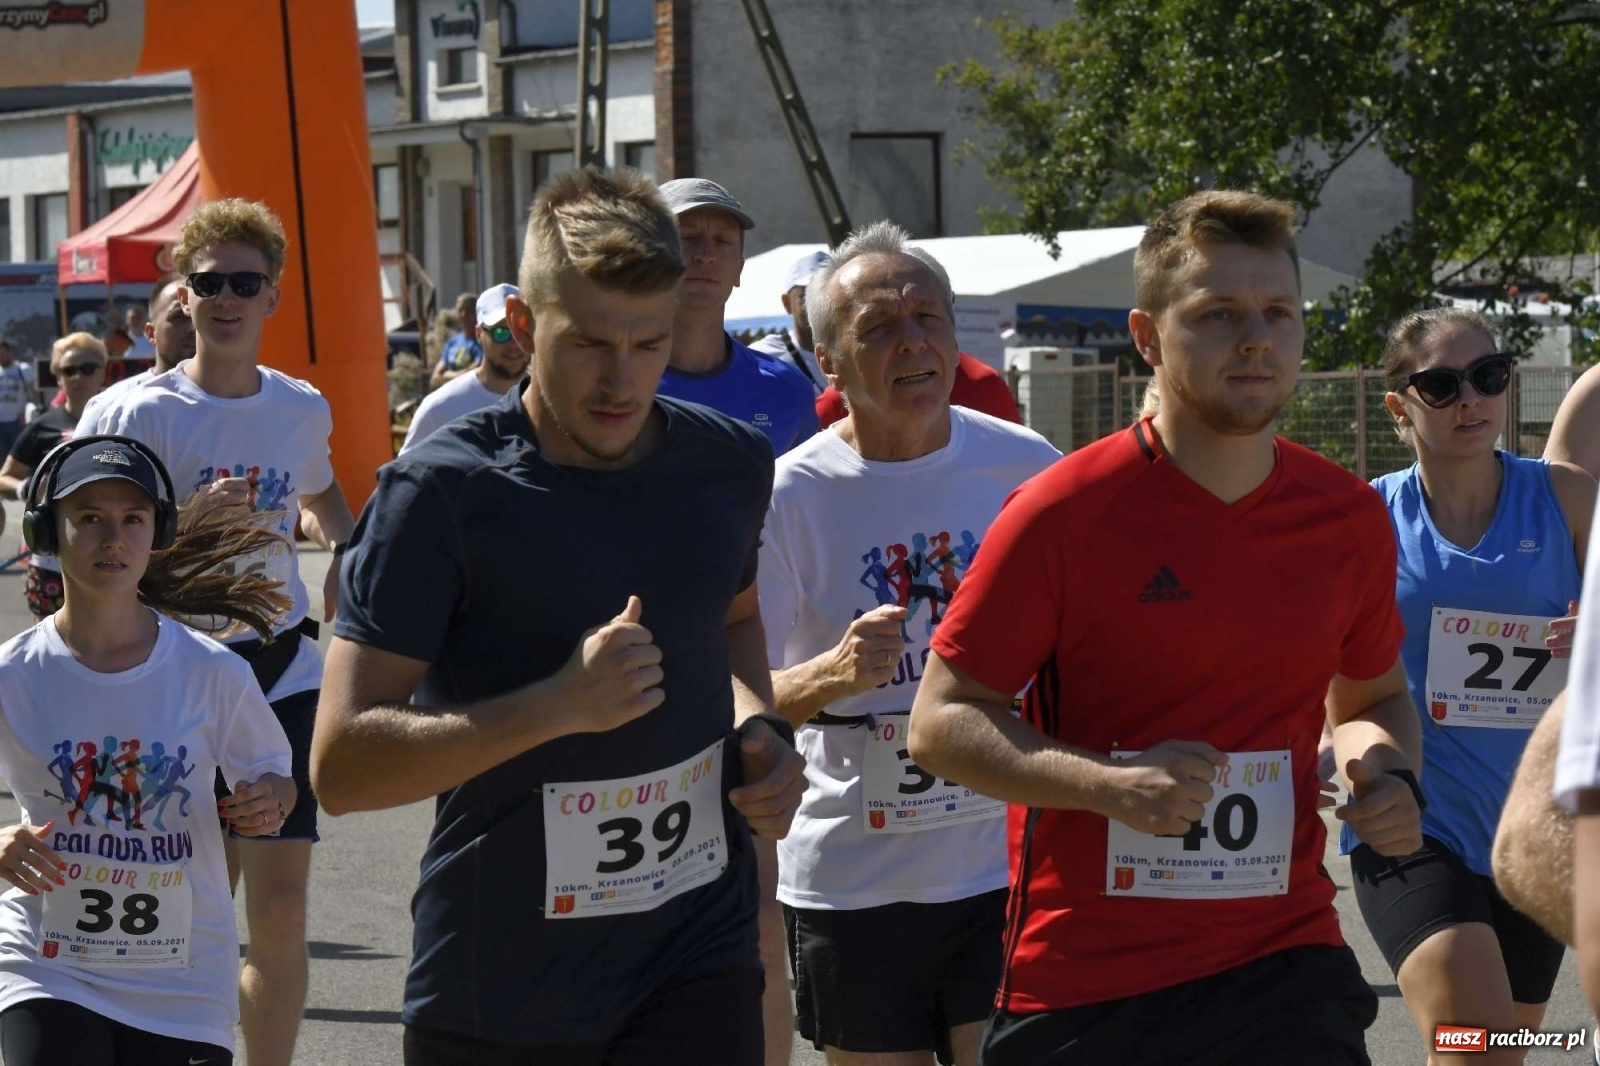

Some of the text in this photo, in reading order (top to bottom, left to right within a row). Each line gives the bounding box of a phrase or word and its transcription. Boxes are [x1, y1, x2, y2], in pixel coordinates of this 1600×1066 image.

[1442, 617, 1530, 643] COLOUR
[1464, 642, 1552, 692] 27
[1431, 692, 1461, 701] 10km,
[1464, 693, 1521, 705] Krzanowice,
[560, 753, 714, 815] COLOUR RUN
[896, 748, 962, 795] 3
[1242, 761, 1280, 788] RUN
[868, 793, 959, 808] 10km, Krzanowice,
[151, 829, 193, 862] RUN
[595, 800, 692, 874] 39
[554, 884, 593, 894] 10km,
[597, 868, 668, 889] Krzanowice,
[671, 836, 722, 869] 05.09.2021
[1114, 854, 1286, 868] 10km, Krzanowice, 05.09.2021
[60, 863, 183, 891] OLOUR RUN
[75, 888, 160, 936] 38
[45, 930, 186, 946] 10km, Krzanowice, 05.09.2021
